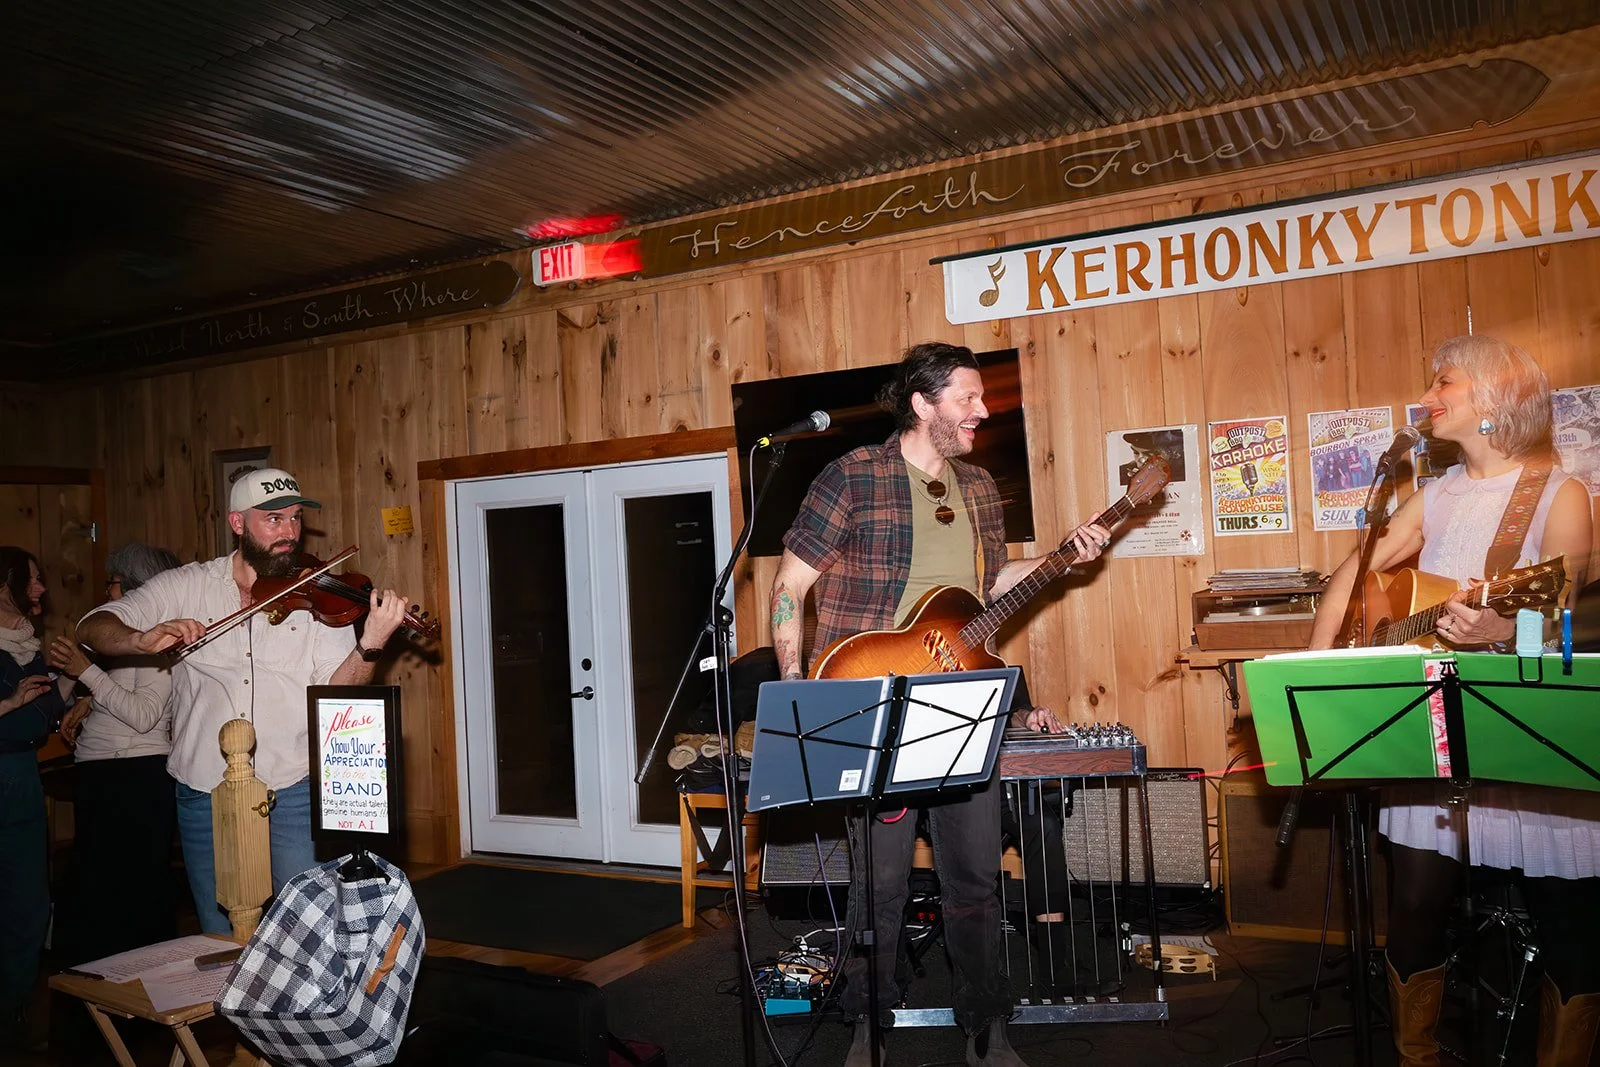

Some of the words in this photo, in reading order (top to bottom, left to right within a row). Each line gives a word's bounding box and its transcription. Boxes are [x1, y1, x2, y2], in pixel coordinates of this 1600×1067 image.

[669, 171, 1025, 258] Henceforth
[1060, 105, 1416, 188] Forever
[1025, 169, 1600, 310] KERHONKYTONK
[540, 244, 574, 282] EXIT
[200, 315, 273, 347] North
[384, 282, 480, 314] Where
[1330, 417, 1370, 430] OUTPOST
[1229, 426, 1265, 438] OUTPOST
[1331, 427, 1346, 437] BBQ
[1310, 440, 1351, 457] BOURBON
[1353, 431, 1391, 447] SPRAWL
[1211, 439, 1286, 469] KARAOKE
[1218, 495, 1283, 508] KERHONKYTONK
[1218, 503, 1283, 514] ROADHOUSE
[1218, 516, 1262, 530] THURS.
[1261, 515, 1269, 524] 6
[1275, 518, 1282, 528] 9
[1320, 509, 1350, 521] SUN
[323, 706, 376, 748] Please
[331, 737, 350, 755] Show
[351, 737, 375, 757] Your
[332, 781, 382, 796] BAND
[323, 796, 338, 808] they
[349, 799, 367, 807] actual
[323, 808, 348, 817] genuine
[350, 809, 377, 817] humans
